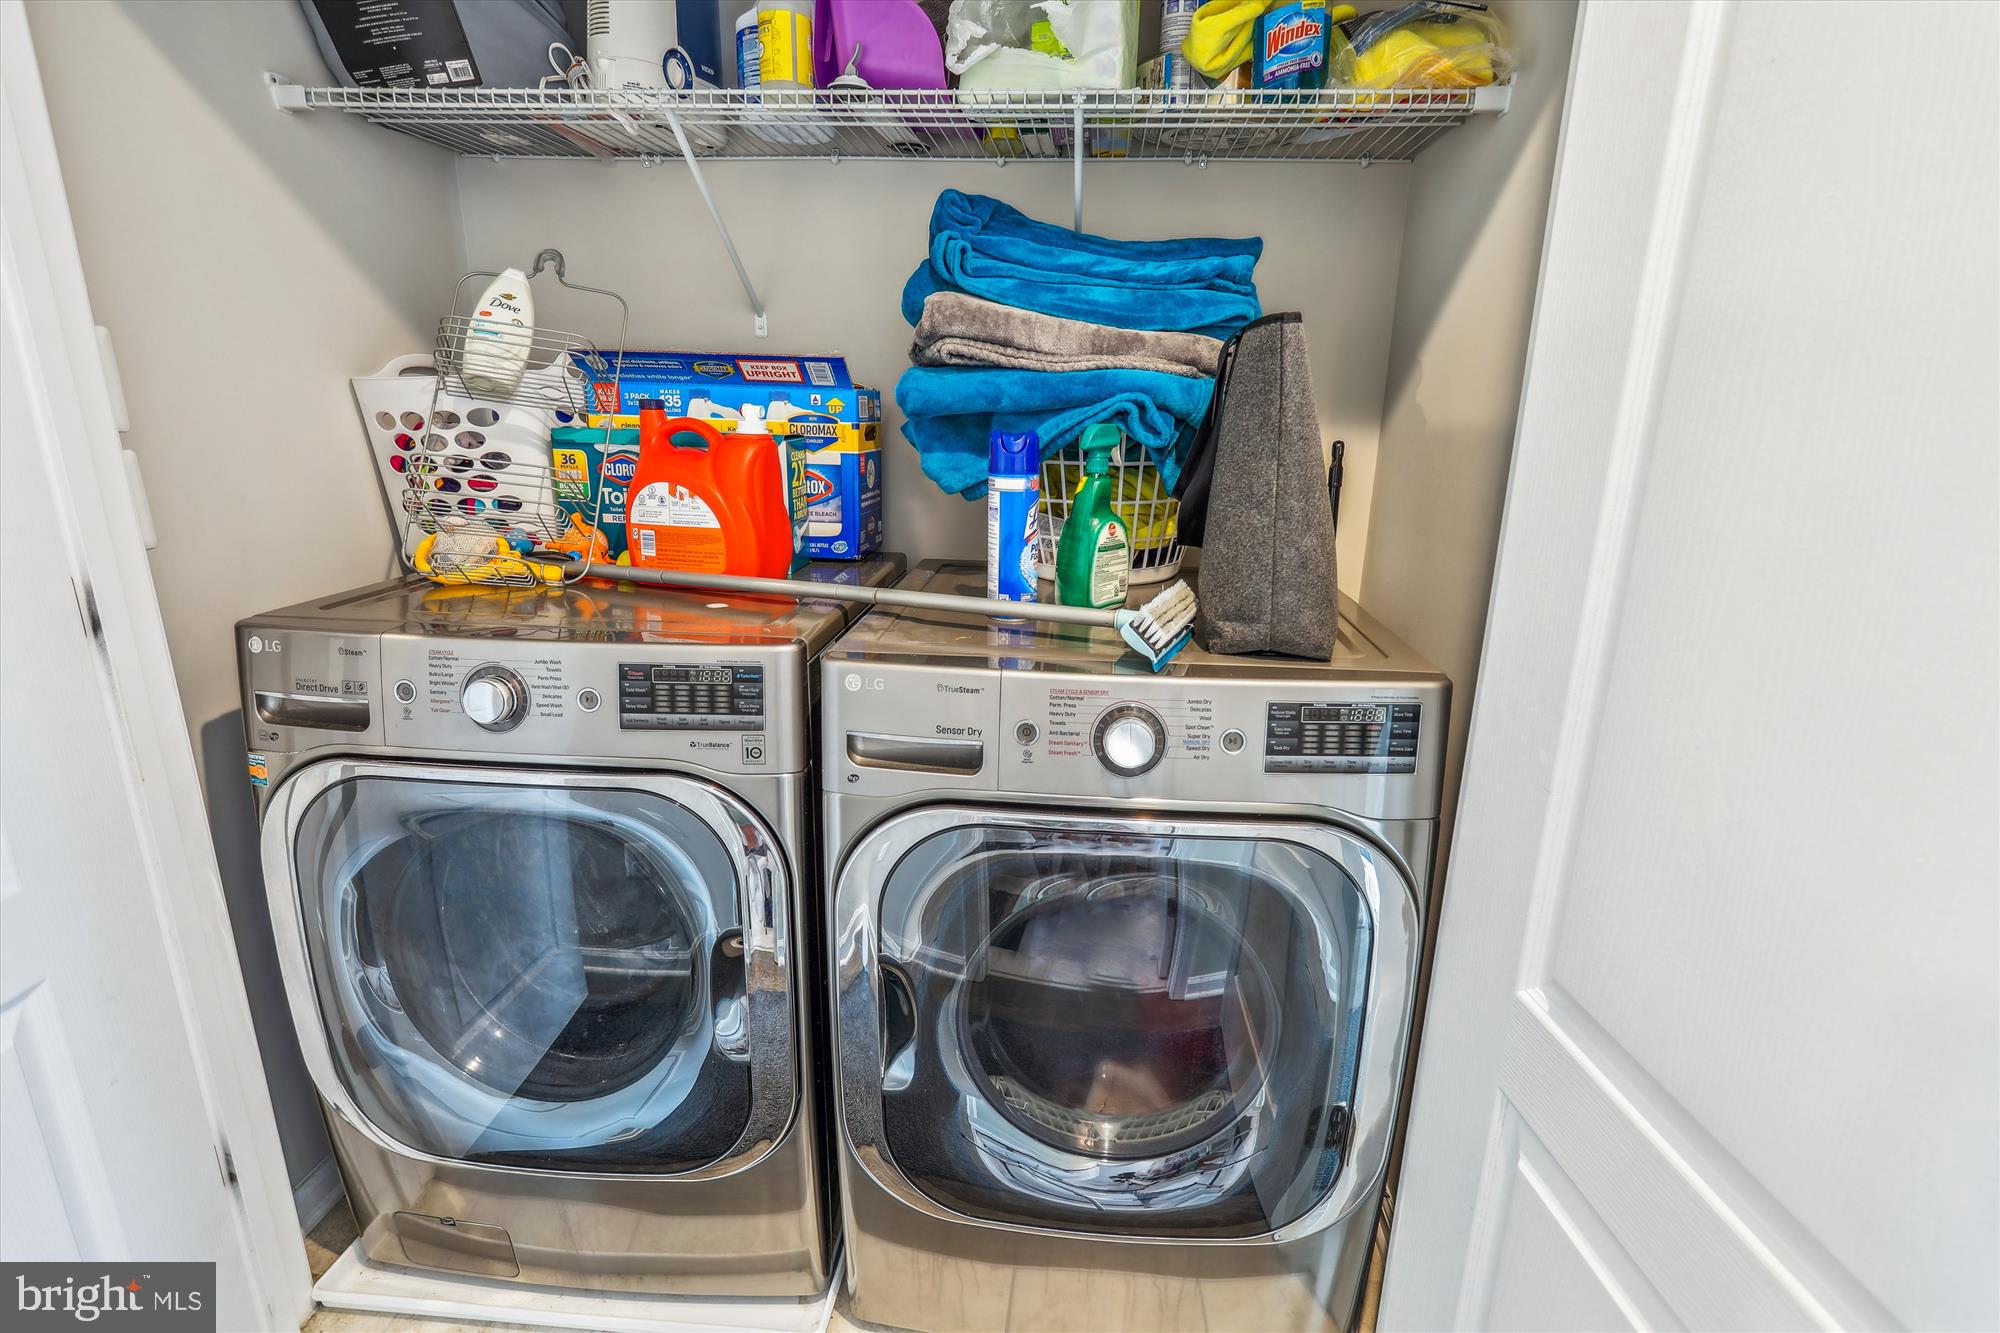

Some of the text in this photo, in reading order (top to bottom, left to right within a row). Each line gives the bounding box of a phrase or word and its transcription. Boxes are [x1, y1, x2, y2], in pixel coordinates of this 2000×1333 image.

[1267, 20, 1321, 60] Windex
[700, 64, 715, 75] VICKS
[1275, 62, 1311, 77] AMMONIA-FREE
[489, 297, 521, 314] Dove
[746, 370, 797, 379] UPRIGHT
[829, 406, 843, 414] UP
[789, 424, 838, 436] CLOROMAX
[561, 454, 576, 465] 36
[604, 464, 636, 476] CLORO
[791, 460, 806, 488] 2X
[806, 480, 826, 494] ROX
[602, 488, 628, 504] Toi
[612, 514, 626, 522] REF
[264, 639, 282, 652] LG
[345, 648, 363, 656] Steam
[295, 683, 339, 693] Direct Drive
[865, 678, 885, 690] LG
[944, 686, 980, 694] TrueSteam
[1350, 709, 1384, 721] 18:88
[936, 725, 982, 738] Sensor Dry
[745, 747, 763, 759] 10
